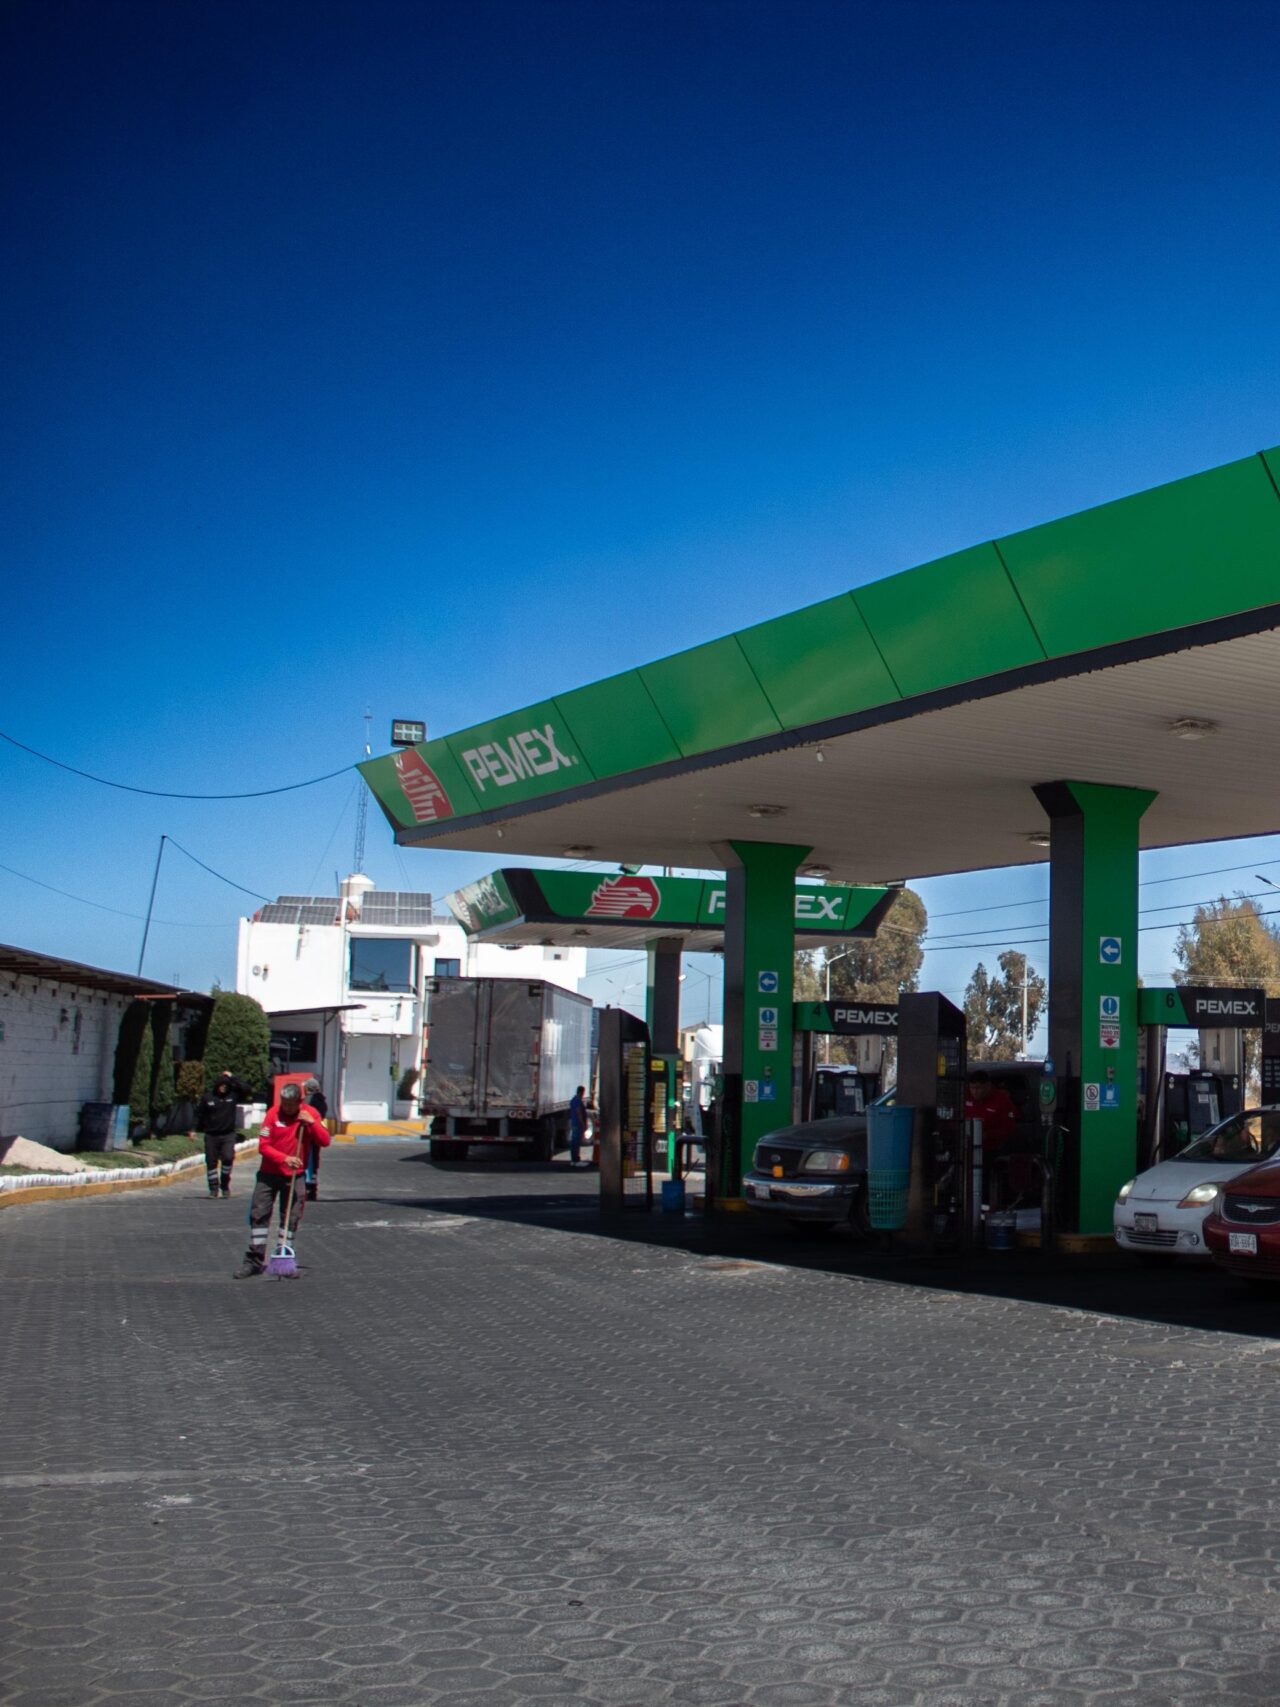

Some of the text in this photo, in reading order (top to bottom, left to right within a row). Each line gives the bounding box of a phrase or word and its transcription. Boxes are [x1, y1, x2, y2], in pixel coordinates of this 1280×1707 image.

[462, 723, 572, 792] PEMEX
[1165, 992, 1176, 1009] 6
[1196, 999, 1256, 1015] PEMEX
[812, 1003, 821, 1017] 4
[834, 1009, 899, 1026] PEMEX
